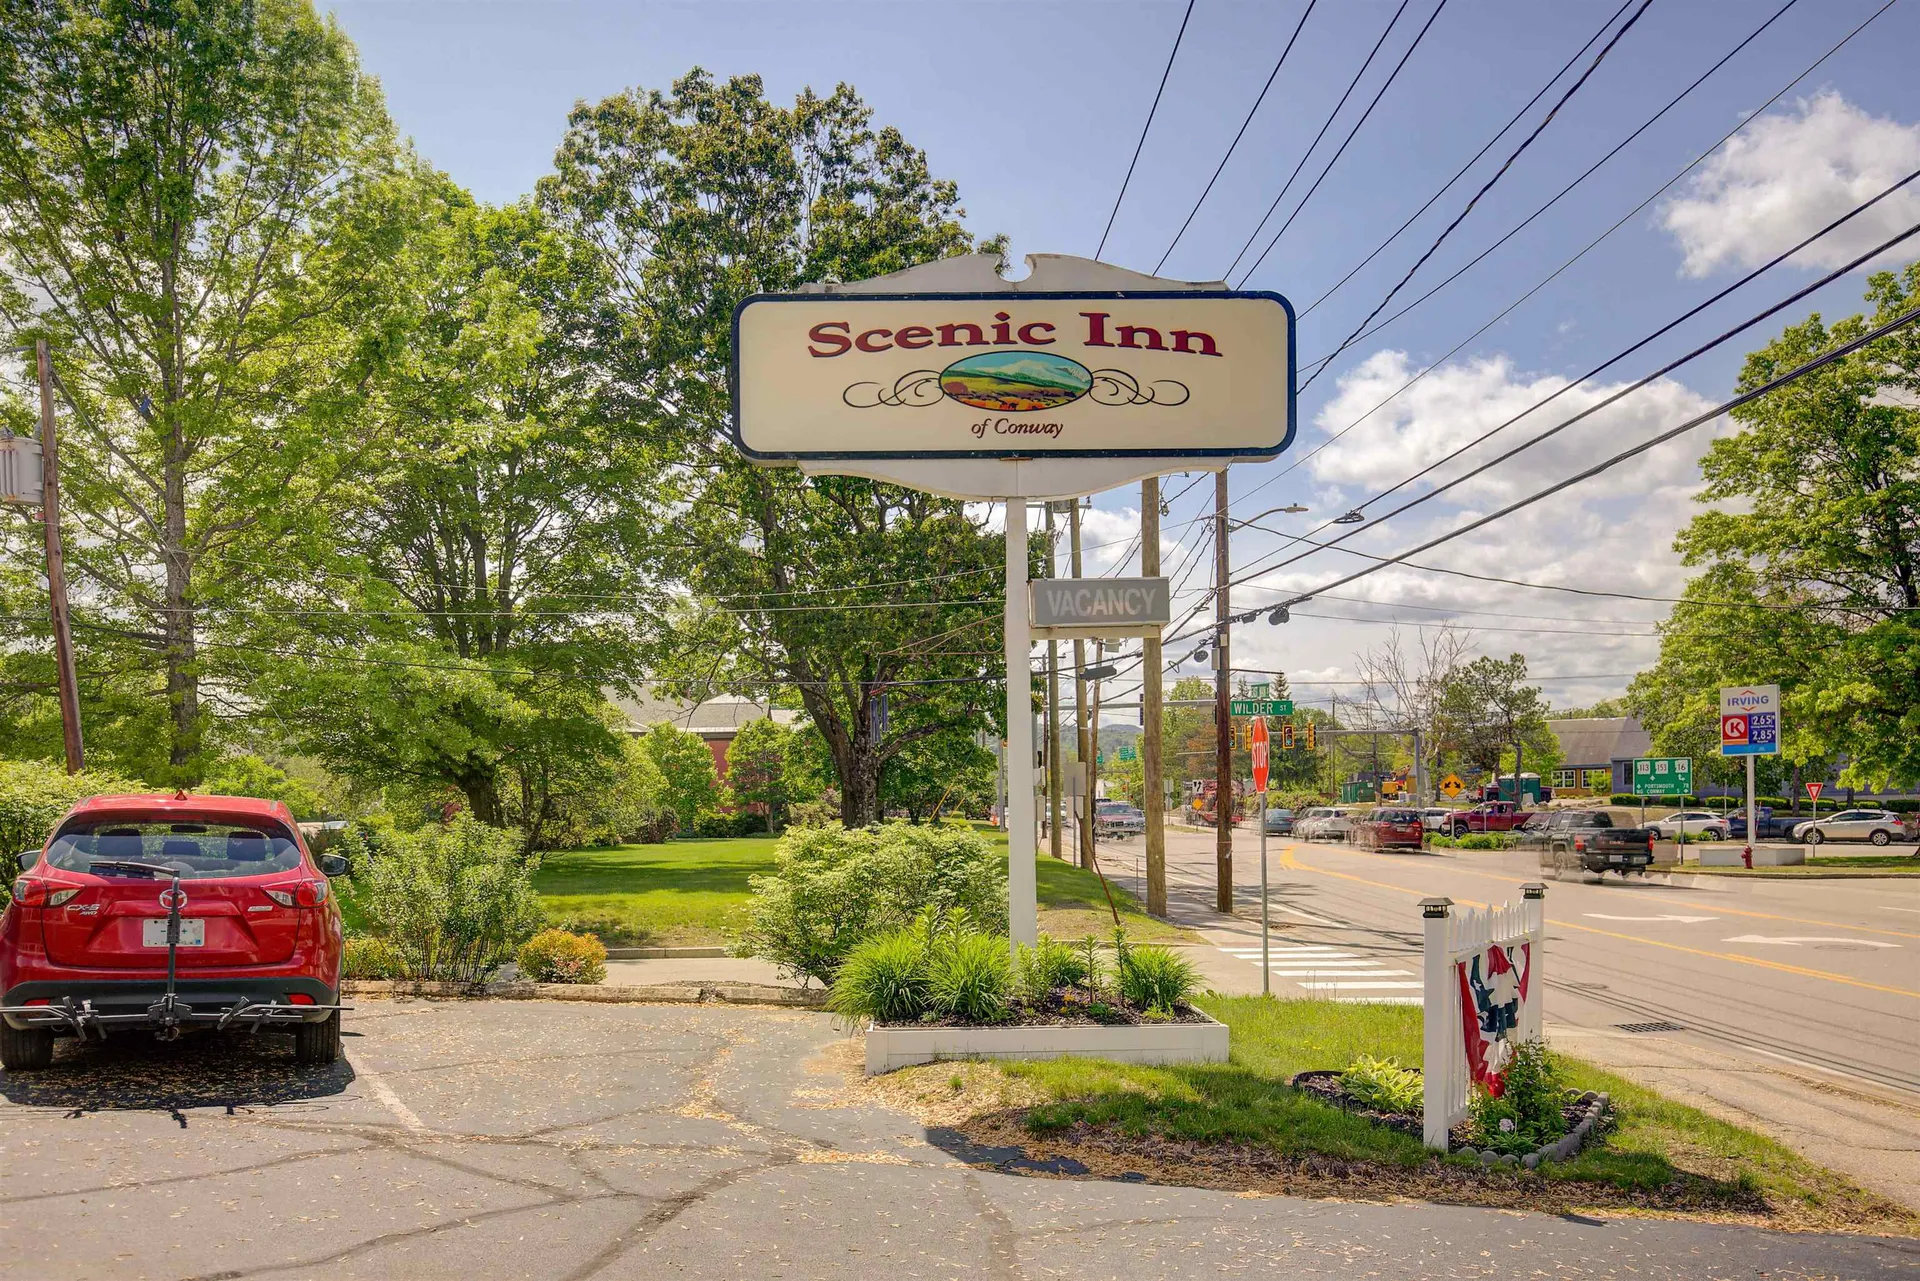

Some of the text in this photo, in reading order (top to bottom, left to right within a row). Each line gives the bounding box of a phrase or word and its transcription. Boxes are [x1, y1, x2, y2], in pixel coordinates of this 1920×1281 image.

[807, 311, 1224, 358] Scenic Inn
[971, 418, 1064, 439] of Conway
[1046, 588, 1157, 618] VACANCY
[1233, 702, 1274, 714] WILDER
[1727, 695, 1769, 706] IRVING
[1730, 722, 1743, 734] K
[1252, 741, 1268, 769] STOP
[67, 903, 101, 912] CX-5
